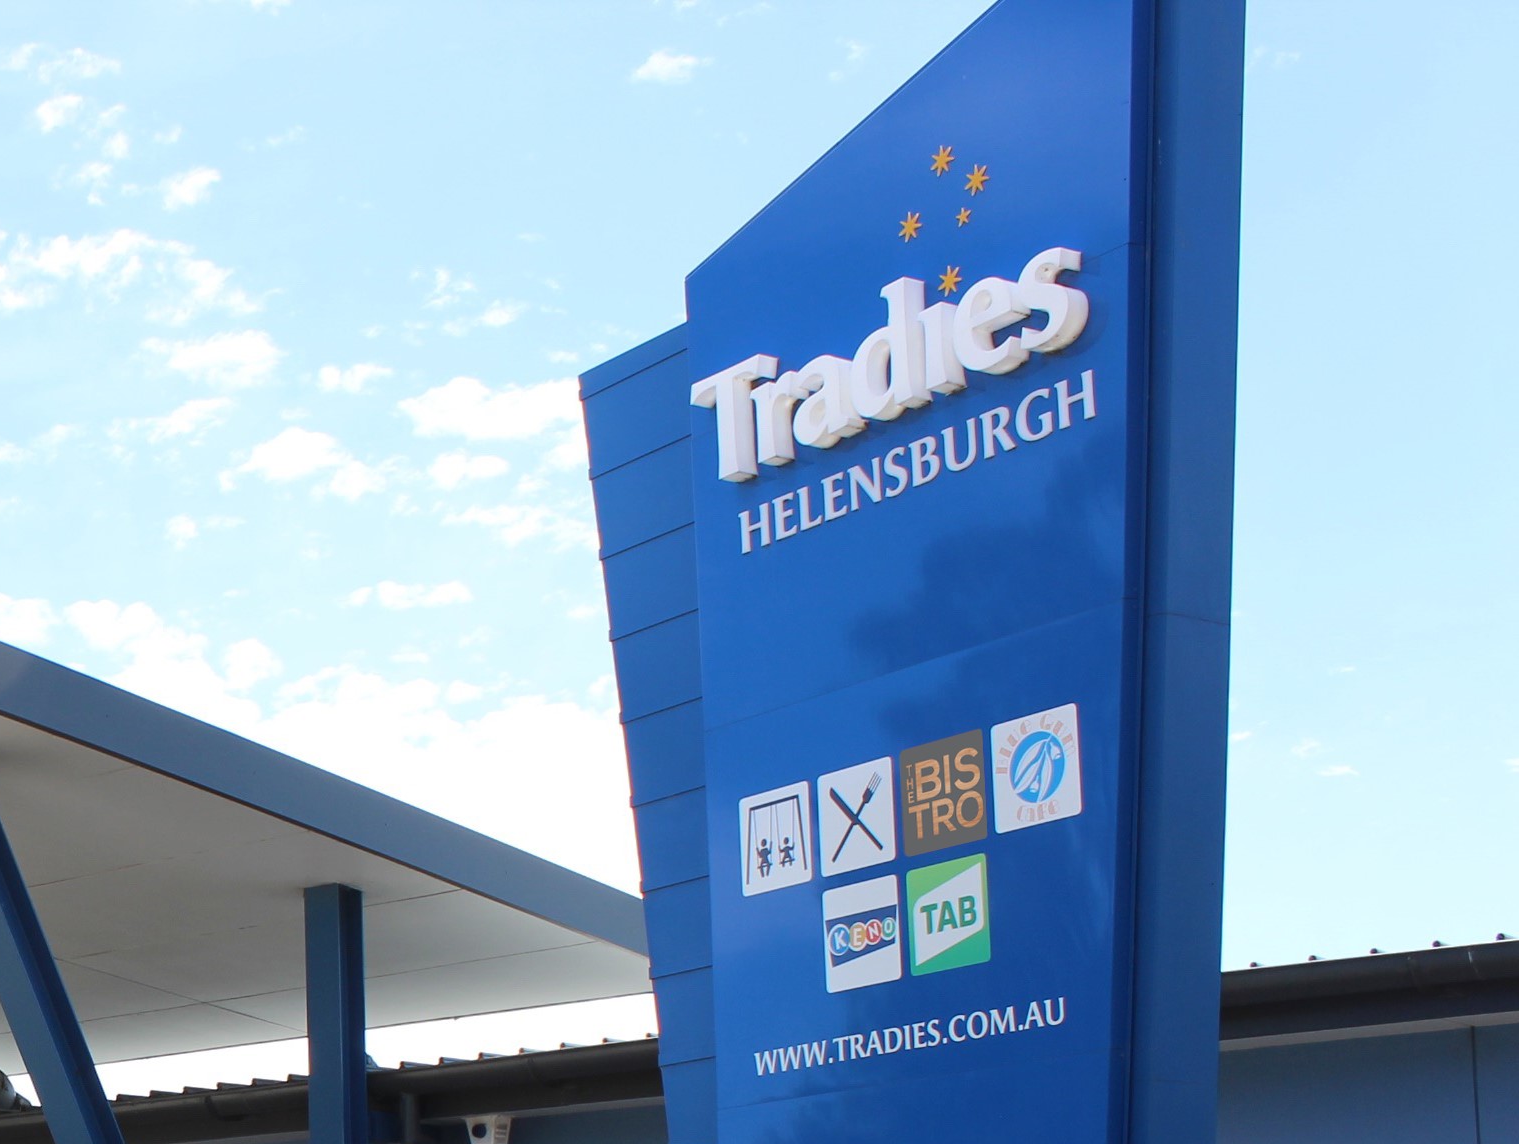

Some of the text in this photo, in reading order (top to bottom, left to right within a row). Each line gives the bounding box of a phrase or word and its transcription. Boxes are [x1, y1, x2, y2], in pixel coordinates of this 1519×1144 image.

[690, 247, 1089, 483] Tradies
[737, 369, 1097, 554] HELENSBURGH
[906, 764, 915, 804] THE
[914, 747, 981, 802] BIS
[908, 790, 984, 839] TRO
[831, 918, 895, 952] KENO
[920, 895, 977, 935] TAB
[753, 997, 1067, 1077] WWW.TRADIES.COM.AU
